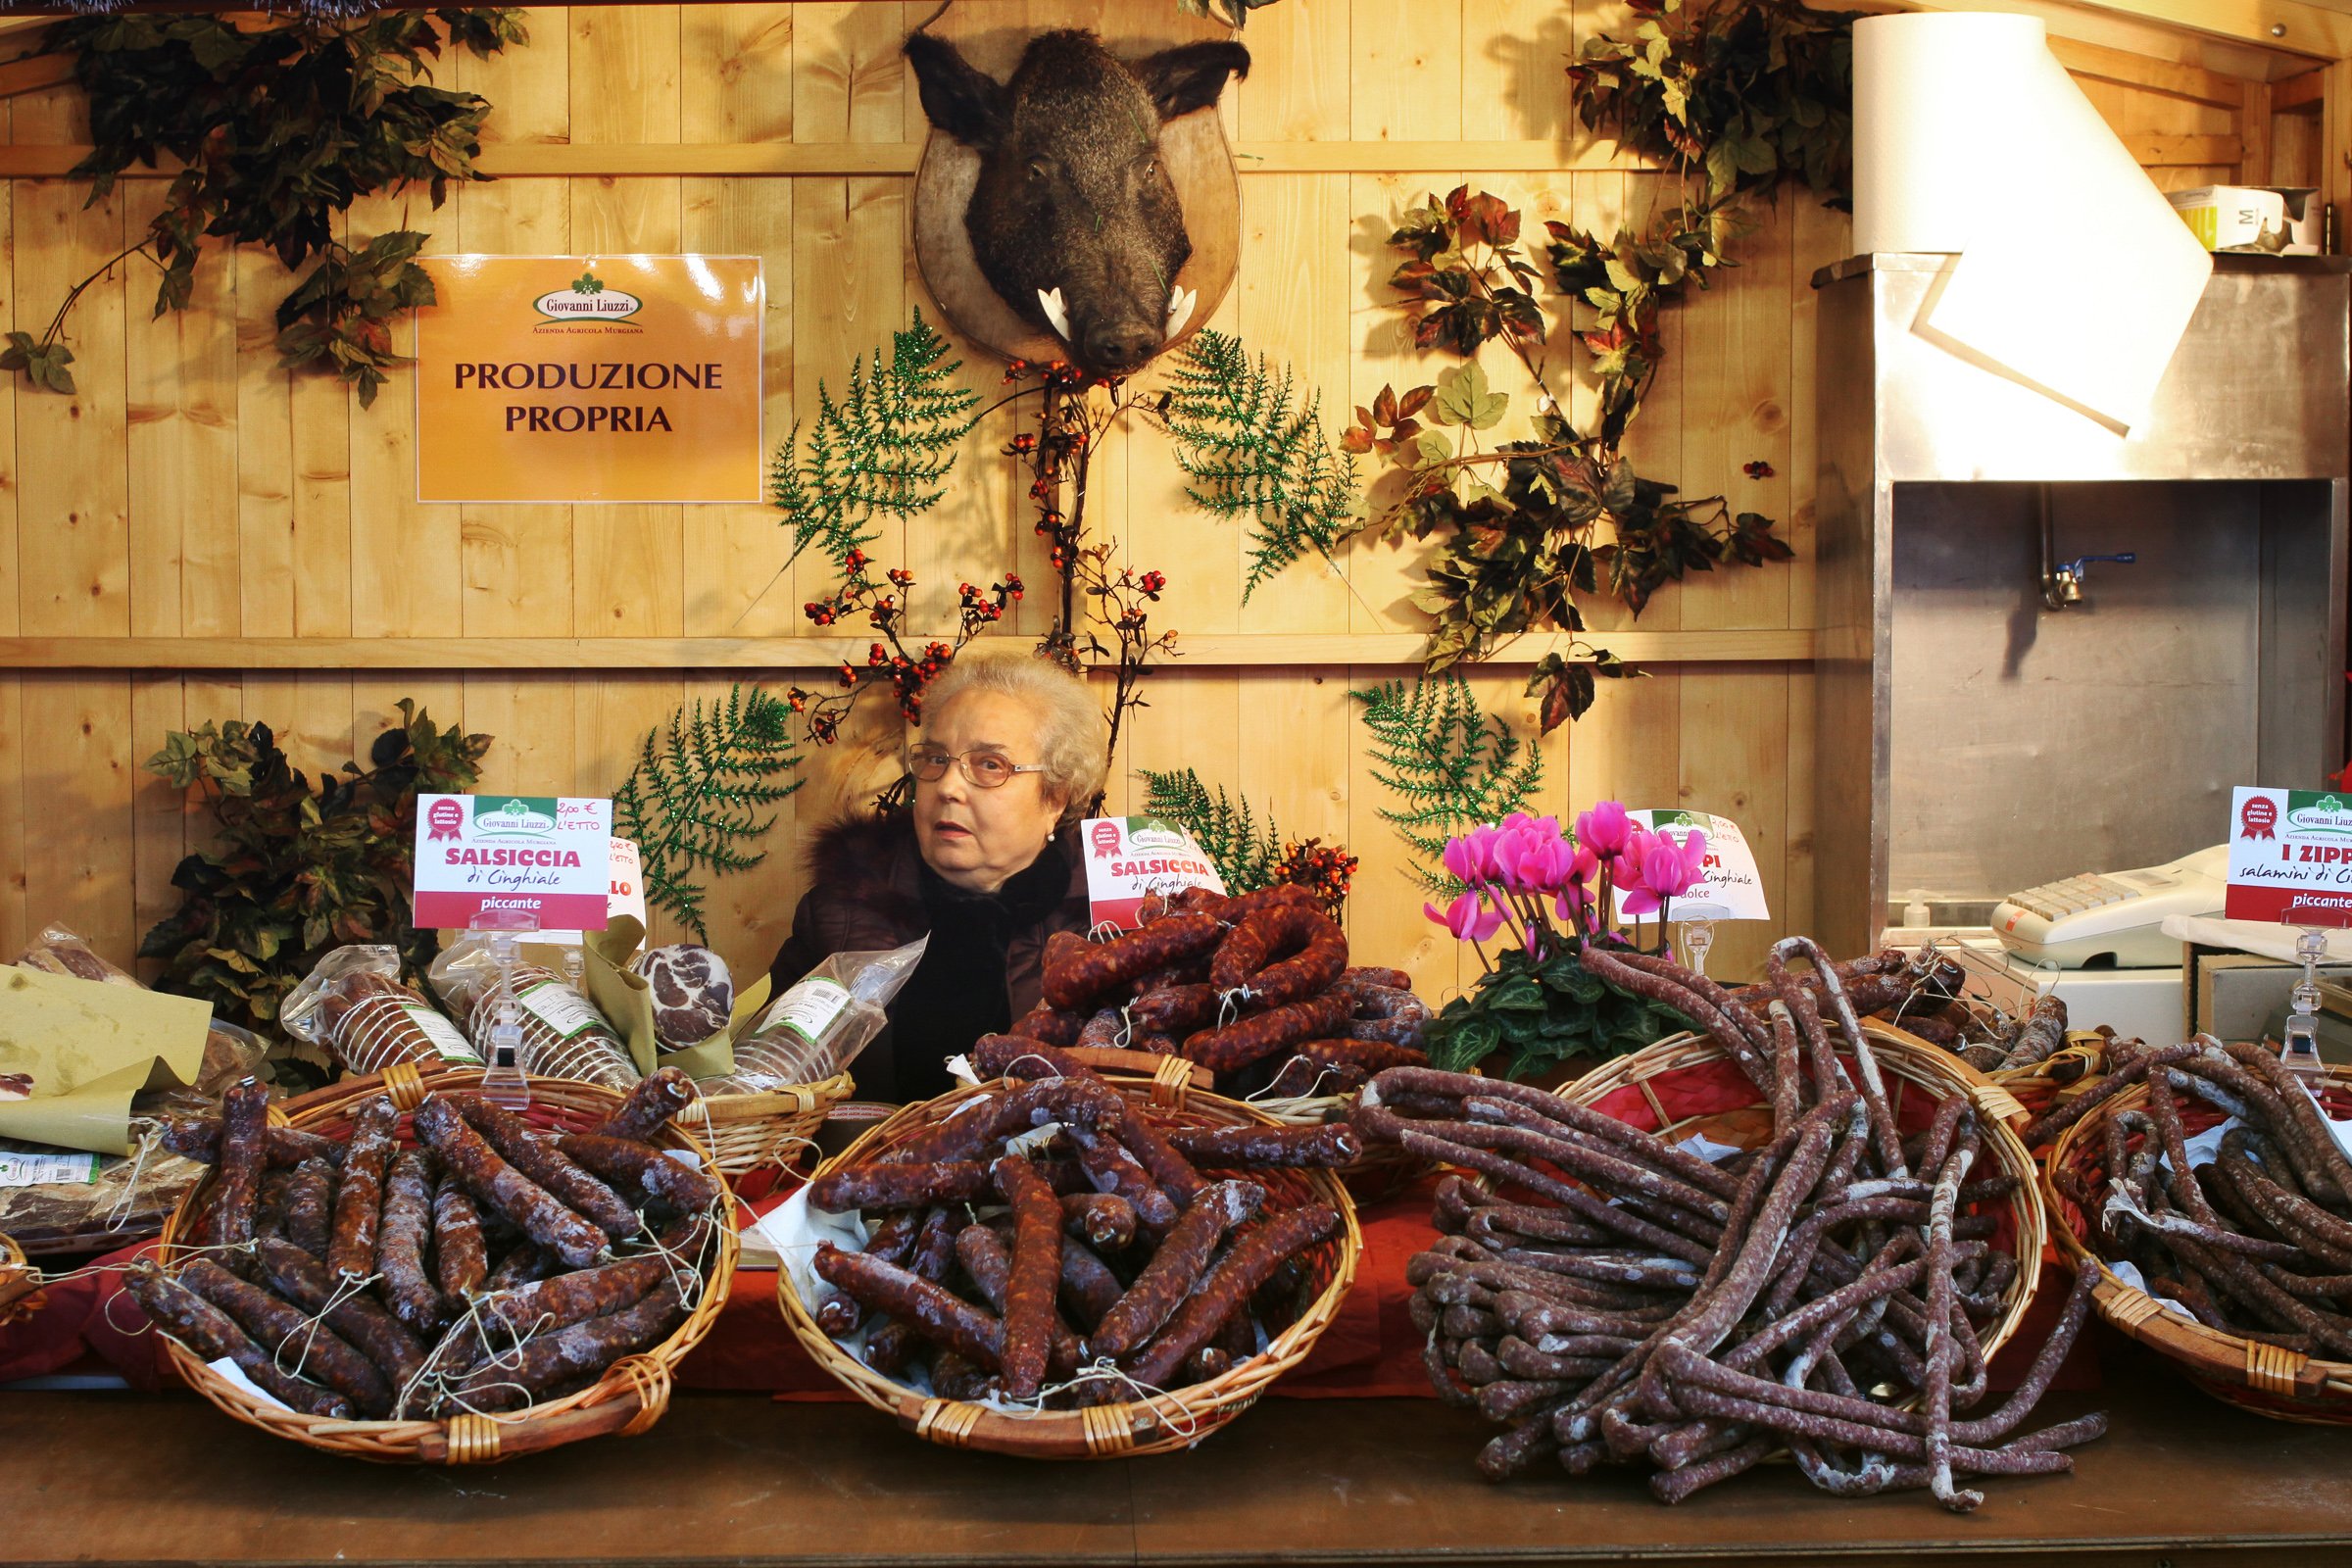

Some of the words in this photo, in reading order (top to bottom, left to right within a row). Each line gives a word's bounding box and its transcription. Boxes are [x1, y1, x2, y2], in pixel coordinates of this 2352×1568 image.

[546, 298, 593, 312] Giovanni
[597, 298, 629, 312] Liuzzi
[455, 363, 722, 390] PRODUZIONE
[506, 406, 673, 432] PROPRIA
[483, 817, 518, 828] Giovanni
[521, 818, 547, 829] Liuzzi
[557, 821, 600, 830] L'ETTO
[2297, 813, 2332, 824] Giovanni
[2335, 815, 2352, 826] Liuz
[445, 848, 581, 867] SALSICCIA
[1703, 855, 1721, 867] PI
[2281, 844, 2291, 861] I
[2299, 845, 2352, 864] ZIPP
[1111, 859, 1209, 877] SALSICCIA
[2239, 863, 2309, 880] salamini
[2315, 863, 2333, 881] di
[467, 865, 483, 883] di
[488, 866, 562, 892] Cinghiale
[1132, 876, 1145, 891] di
[1149, 874, 1202, 895] Cinghiale
[1703, 869, 1752, 888] Cinghiale
[611, 880, 632, 896] LO
[480, 896, 542, 911] piccante
[2292, 893, 2352, 908] piccante
